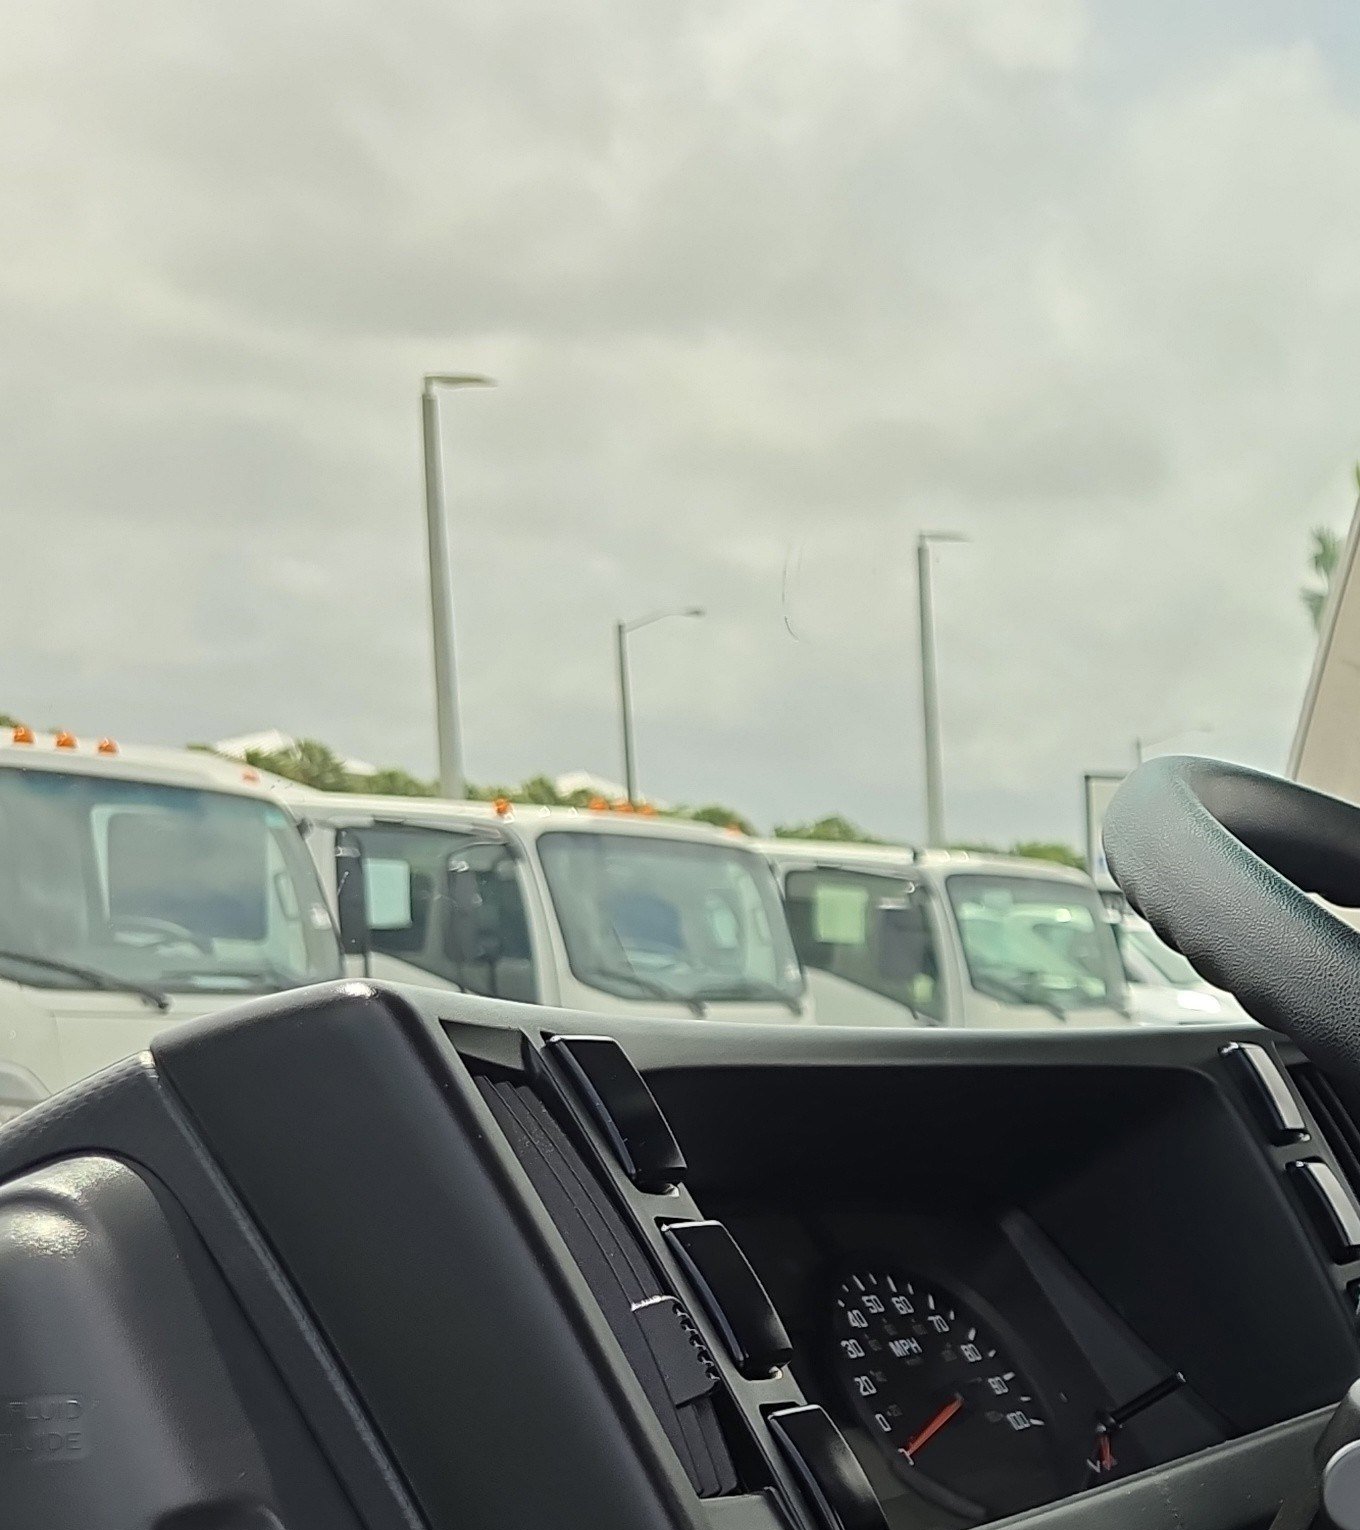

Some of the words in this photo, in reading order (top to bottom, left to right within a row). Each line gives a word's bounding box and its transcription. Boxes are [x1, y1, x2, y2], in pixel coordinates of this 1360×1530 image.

[861, 1294, 885, 1314] 50
[891, 1295, 914, 1315] 60
[847, 1309, 869, 1328] 40
[927, 1314, 950, 1332] 70
[840, 1338, 865, 1359] 30
[888, 1337, 923, 1357] MPH
[960, 1343, 982, 1362] 80
[854, 1375, 877, 1396] 20
[987, 1376, 1009, 1395] 90
